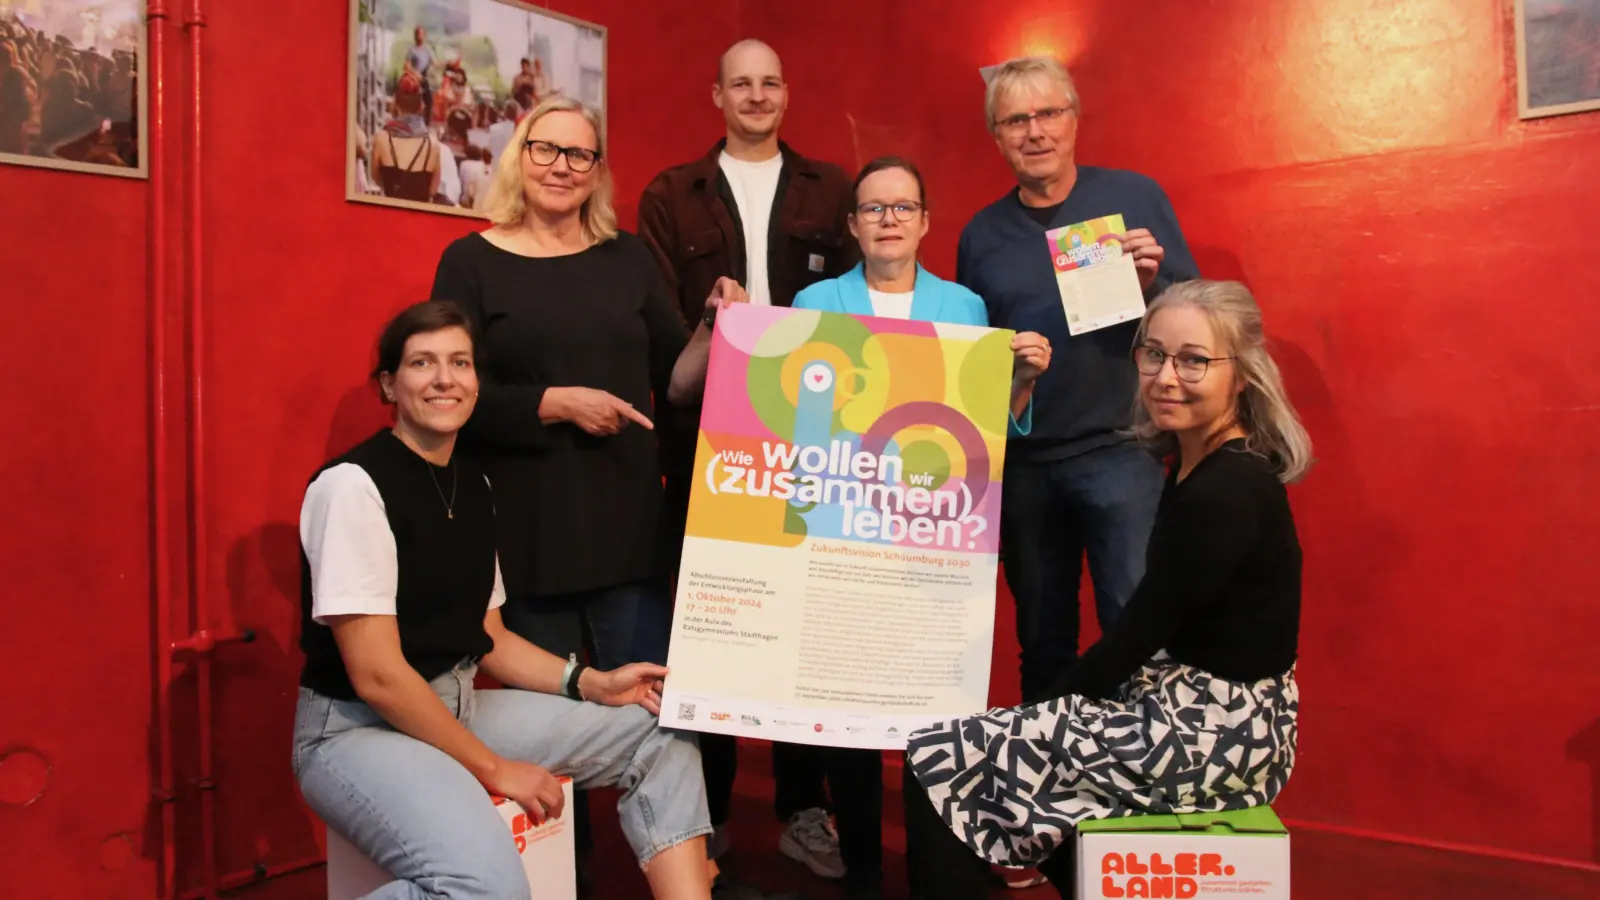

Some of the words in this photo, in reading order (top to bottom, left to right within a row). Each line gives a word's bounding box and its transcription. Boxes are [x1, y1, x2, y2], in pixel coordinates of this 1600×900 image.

[722, 449, 753, 466] Wie
[762, 439, 902, 482] wollen
[910, 472, 935, 486] wir
[705, 453, 972, 521] (zusammen)
[840, 502, 988, 550] leben?
[811, 543, 881, 559] Zukunftsvision
[884, 550, 944, 567] Schaumburg
[946, 559, 971, 568] 2030
[696, 591, 736, 605] Oktober
[738, 598, 763, 609] 2024
[700, 582, 764, 595] Entwicklungsphase
[686, 603, 696, 612] 17
[704, 605, 717, 613] 20
[719, 605, 737, 616] Uhr
[683, 624, 739, 637] Ratsgymnasiums
[740, 630, 779, 642] Stadthagen
[704, 617, 719, 625] Aula
[720, 619, 732, 627] des
[1101, 852, 1236, 876] ALLER.
[1101, 876, 1198, 899] LAND
